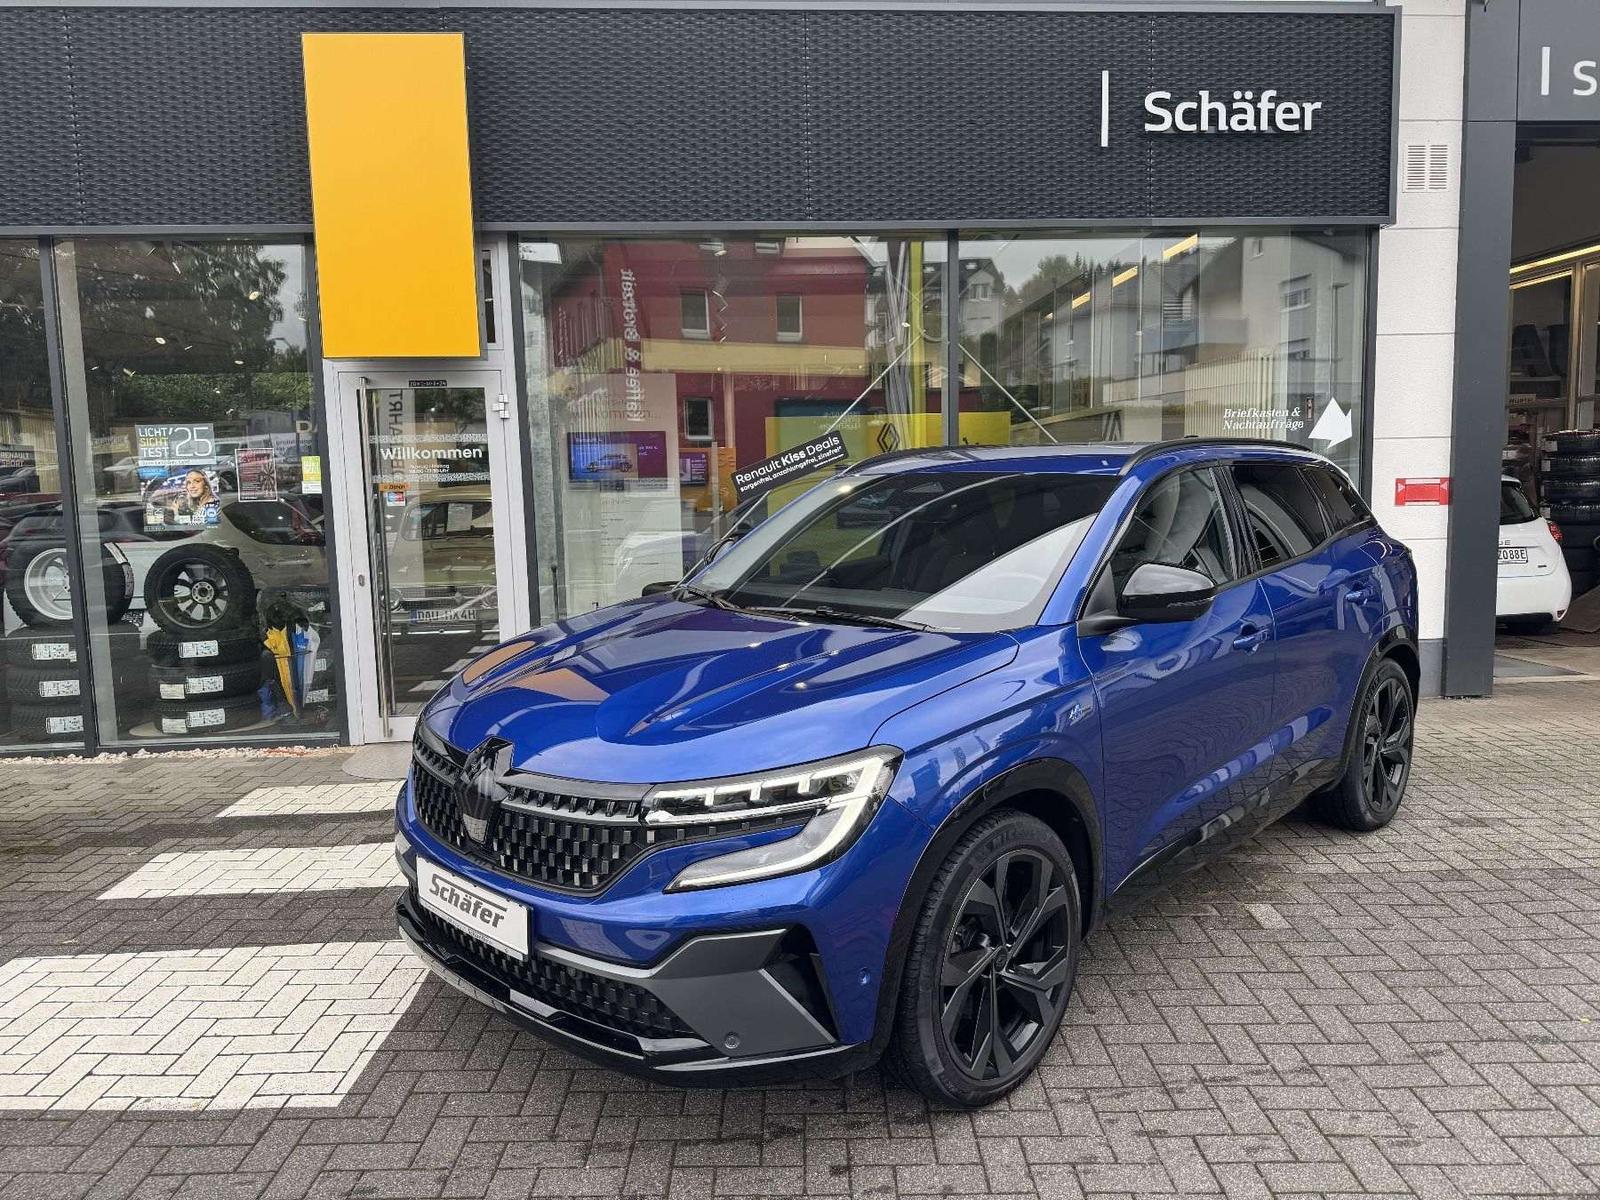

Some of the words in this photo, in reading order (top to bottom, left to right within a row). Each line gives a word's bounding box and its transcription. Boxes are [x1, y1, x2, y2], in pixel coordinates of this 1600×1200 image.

[1144, 89, 1322, 132] Schäfer
[1223, 407, 1289, 418] Briefkasten
[1291, 406, 1301, 417] &
[1223, 419, 1304, 431] Nachtaufträge
[138, 427, 168, 437] LICHT
[139, 437, 169, 447] SICHT
[140, 447, 169, 458] TEST
[380, 446, 482, 460] Willkommen
[735, 460, 782, 485] Renault
[781, 450, 806, 467] Kiss
[805, 436, 840, 456] Deals
[429, 874, 506, 928] Schäfer
